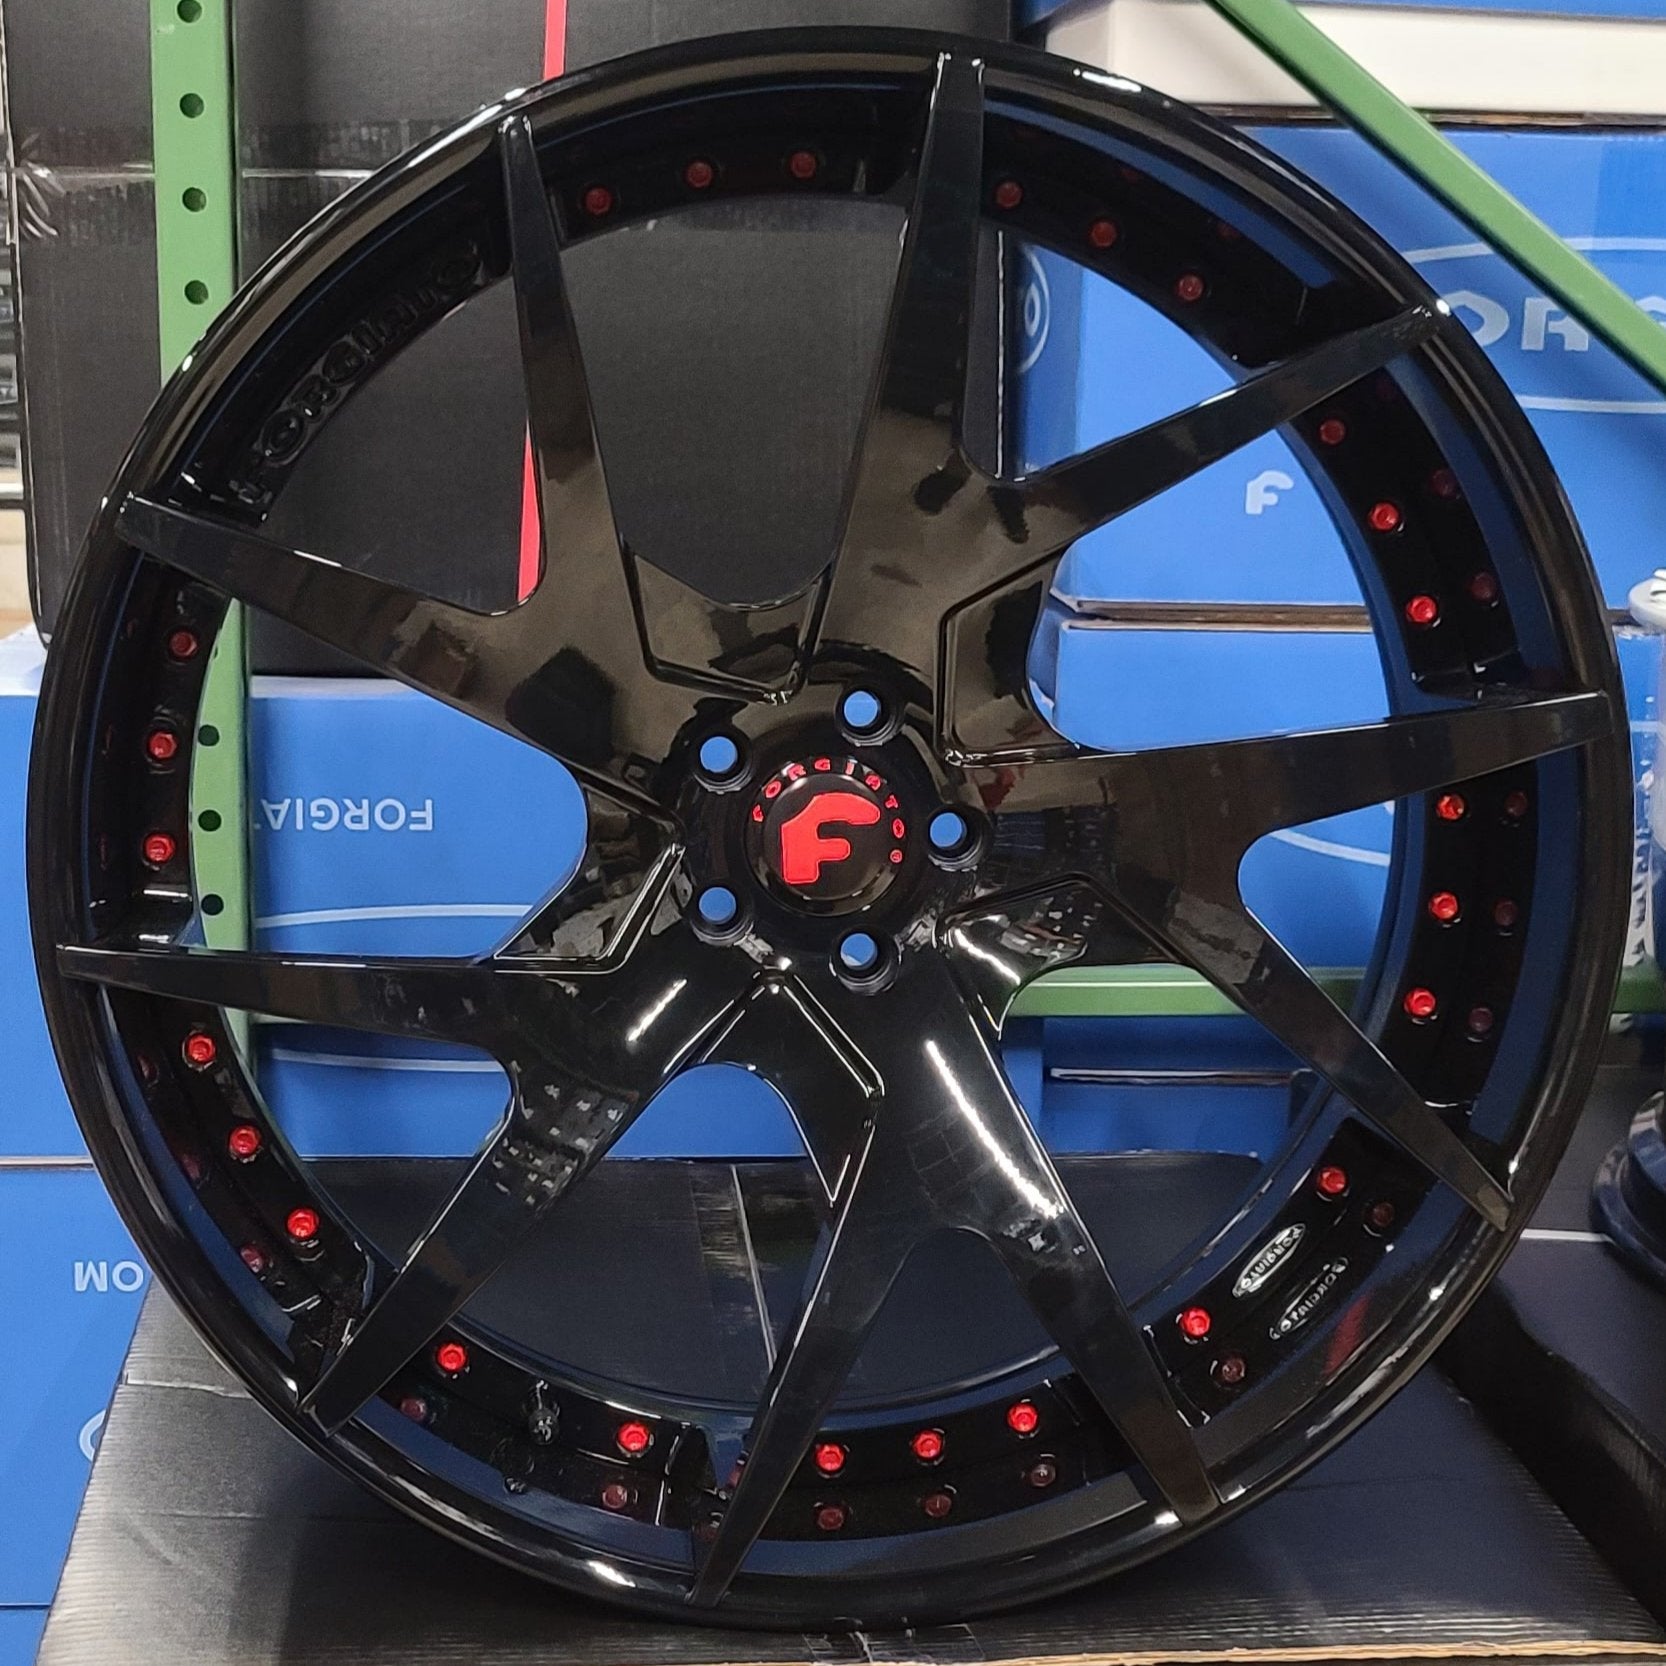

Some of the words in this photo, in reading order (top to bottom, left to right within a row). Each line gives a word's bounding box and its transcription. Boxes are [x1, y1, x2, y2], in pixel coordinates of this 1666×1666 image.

[1438, 290, 1666, 351] OR
[254, 798, 433, 831] FORGIA
[781, 792, 881, 884] F
